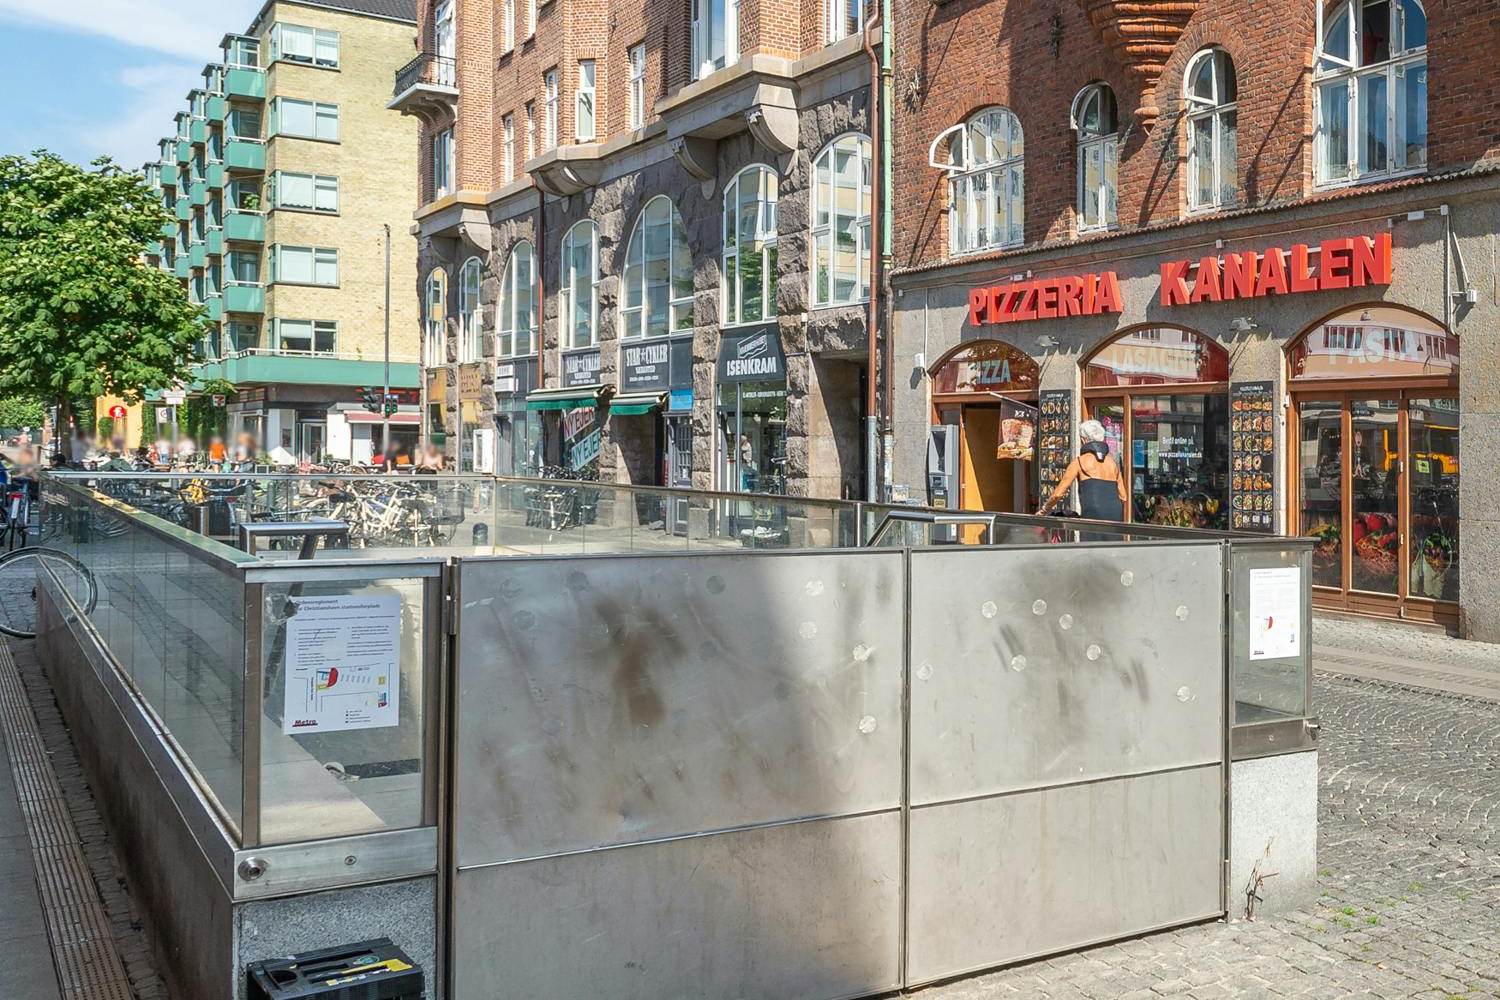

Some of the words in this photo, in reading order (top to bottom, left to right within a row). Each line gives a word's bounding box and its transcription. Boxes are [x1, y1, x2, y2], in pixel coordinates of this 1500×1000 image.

[968, 271, 1123, 326] PIZZERIA
[1160, 233, 1392, 307] KANALEN
[626, 347, 641, 367] STAR
[726, 356, 777, 377] ISENKRAM
[293, 719, 318, 727] Metro
